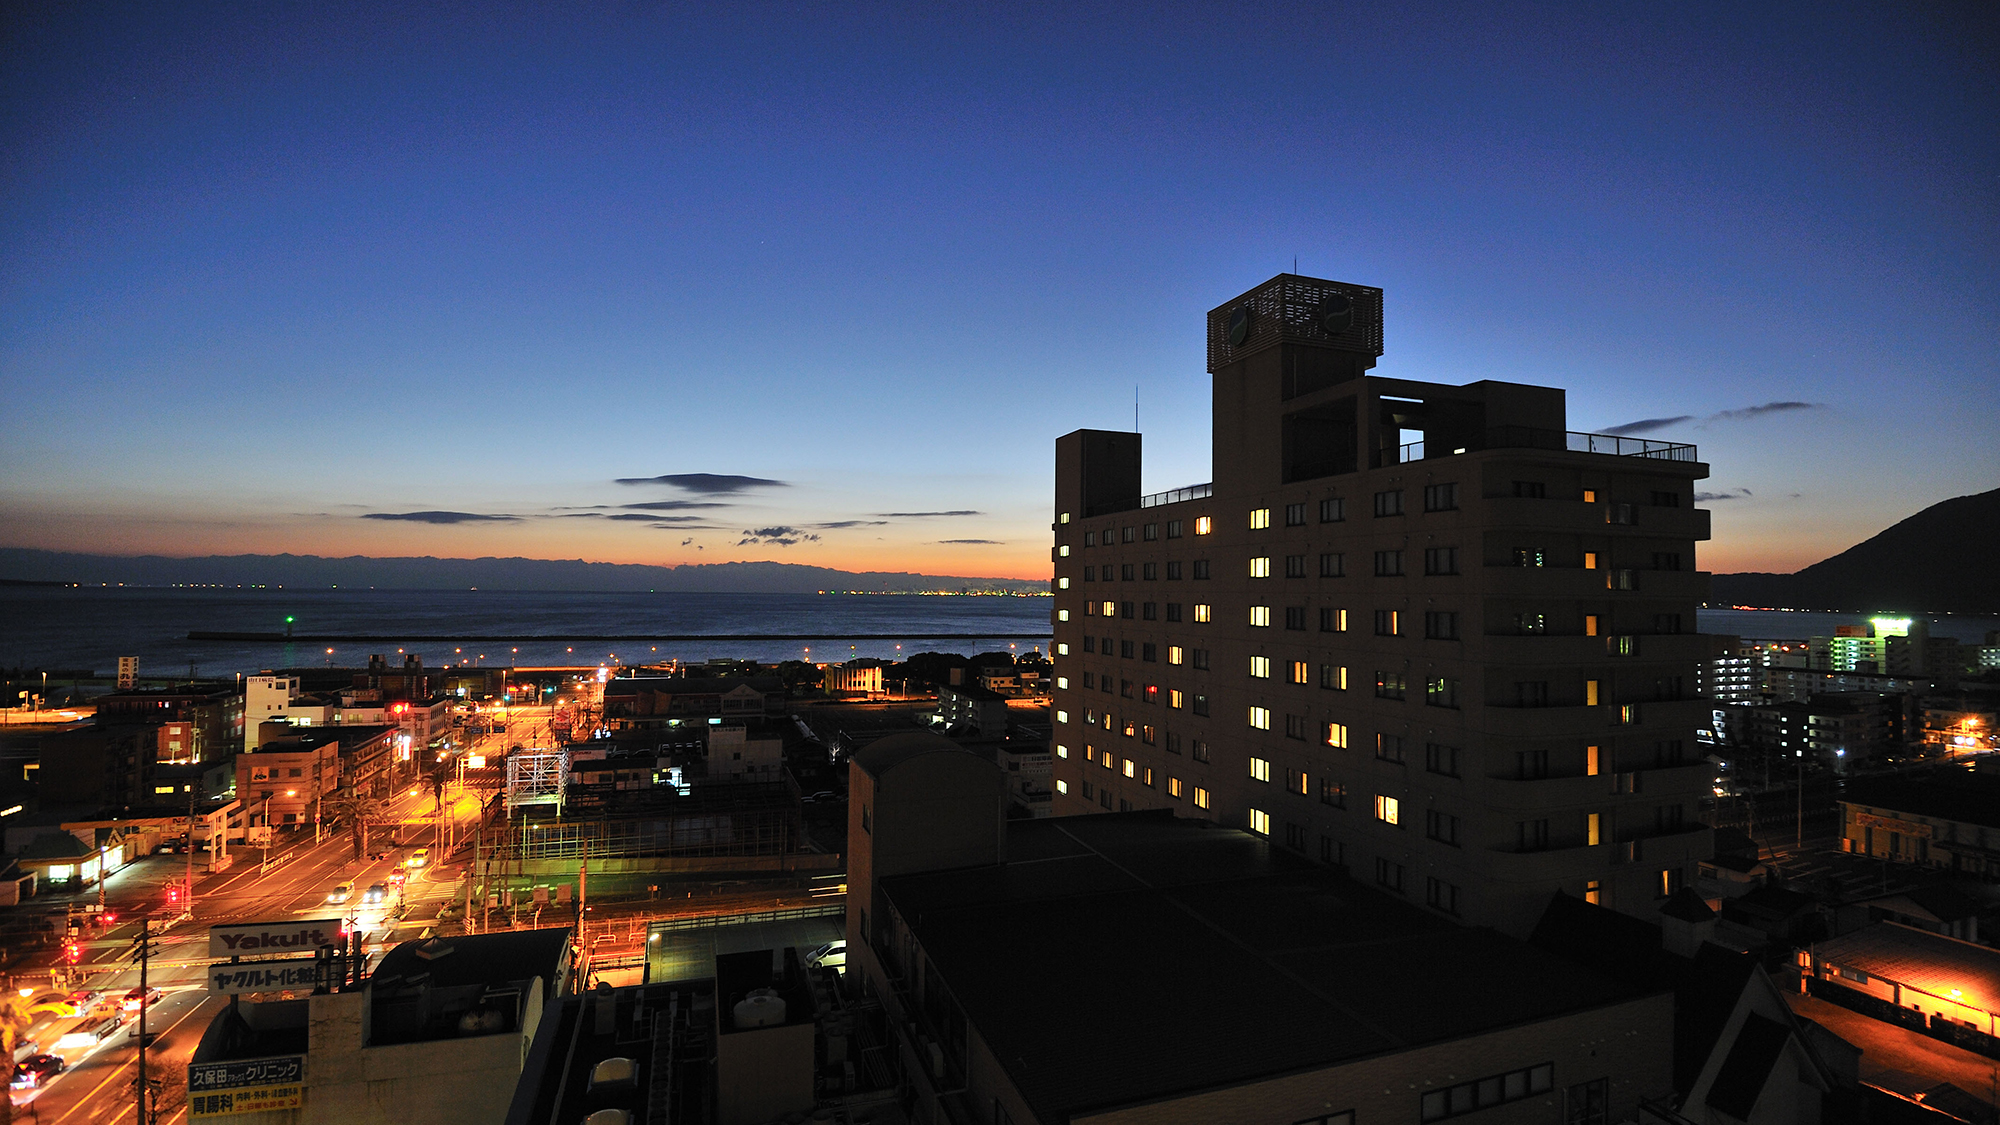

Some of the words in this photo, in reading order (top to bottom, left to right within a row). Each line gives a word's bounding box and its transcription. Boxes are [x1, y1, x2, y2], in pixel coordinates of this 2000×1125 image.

[219, 929, 329, 950] Yakult
[193, 1093, 234, 1115] 胃腸科
